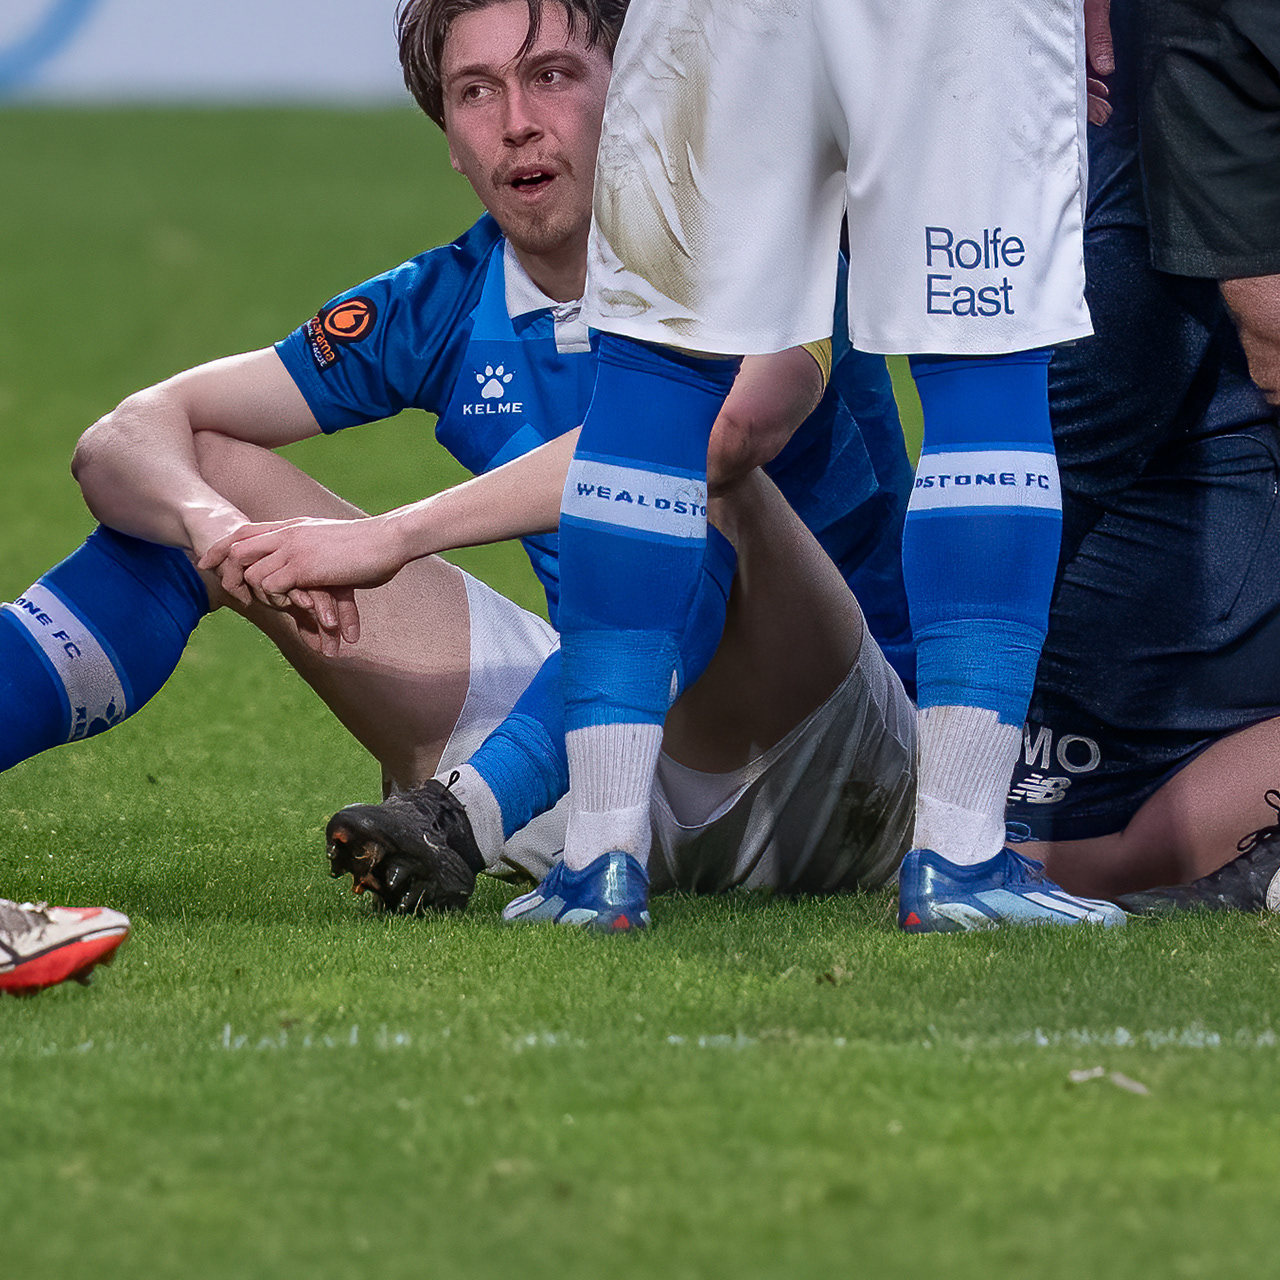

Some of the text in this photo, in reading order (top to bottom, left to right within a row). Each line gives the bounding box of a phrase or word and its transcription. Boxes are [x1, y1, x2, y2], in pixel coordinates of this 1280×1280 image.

[924, 226, 1026, 270] Rolfe
[926, 273, 1015, 318] East
[462, 402, 524, 416] KELME
[1025, 472, 1050, 490] FC
[51, 630, 82, 660] FC
